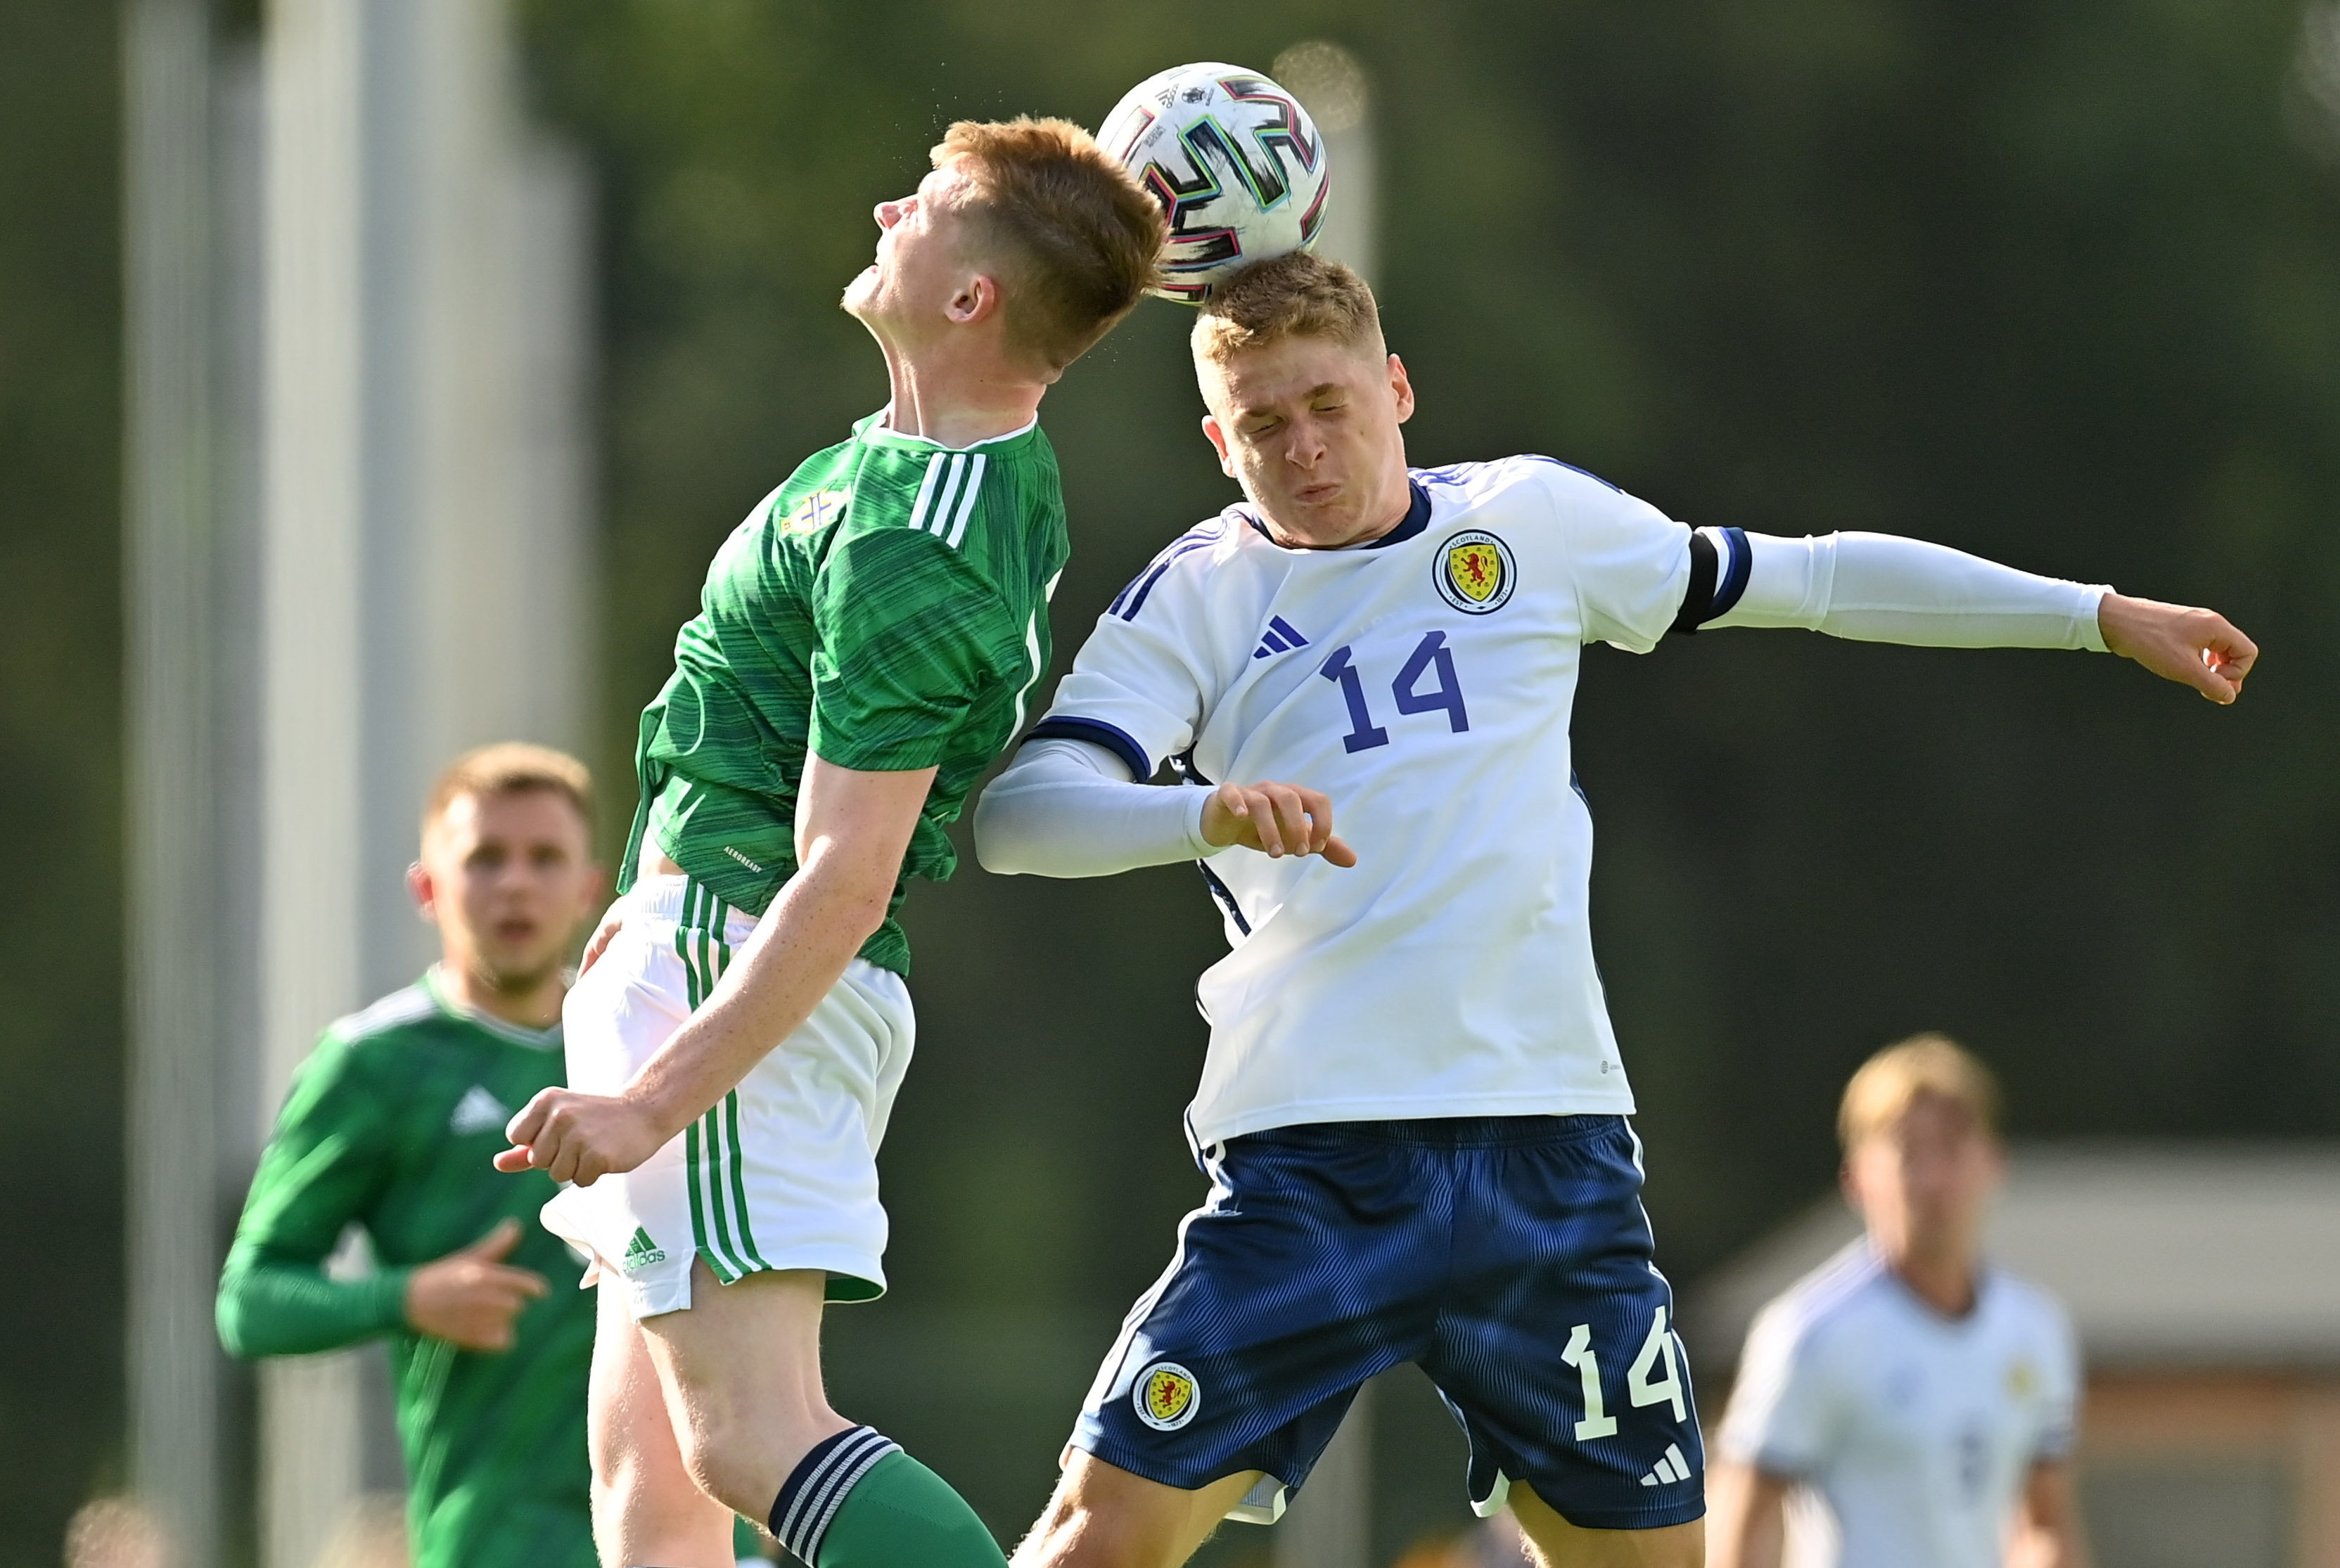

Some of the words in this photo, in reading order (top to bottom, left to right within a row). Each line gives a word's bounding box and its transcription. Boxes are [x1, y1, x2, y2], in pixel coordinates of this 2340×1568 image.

[1452, 535, 1490, 546] SCOTLAND
[1452, 598, 1464, 606] EST
[1319, 630, 1469, 754] 14
[723, 846, 762, 873] AEROREADY
[623, 1250, 665, 1271] adidas
[1161, 1366, 1190, 1380] SCOTLAND
[1561, 1306, 1687, 1441] 14
